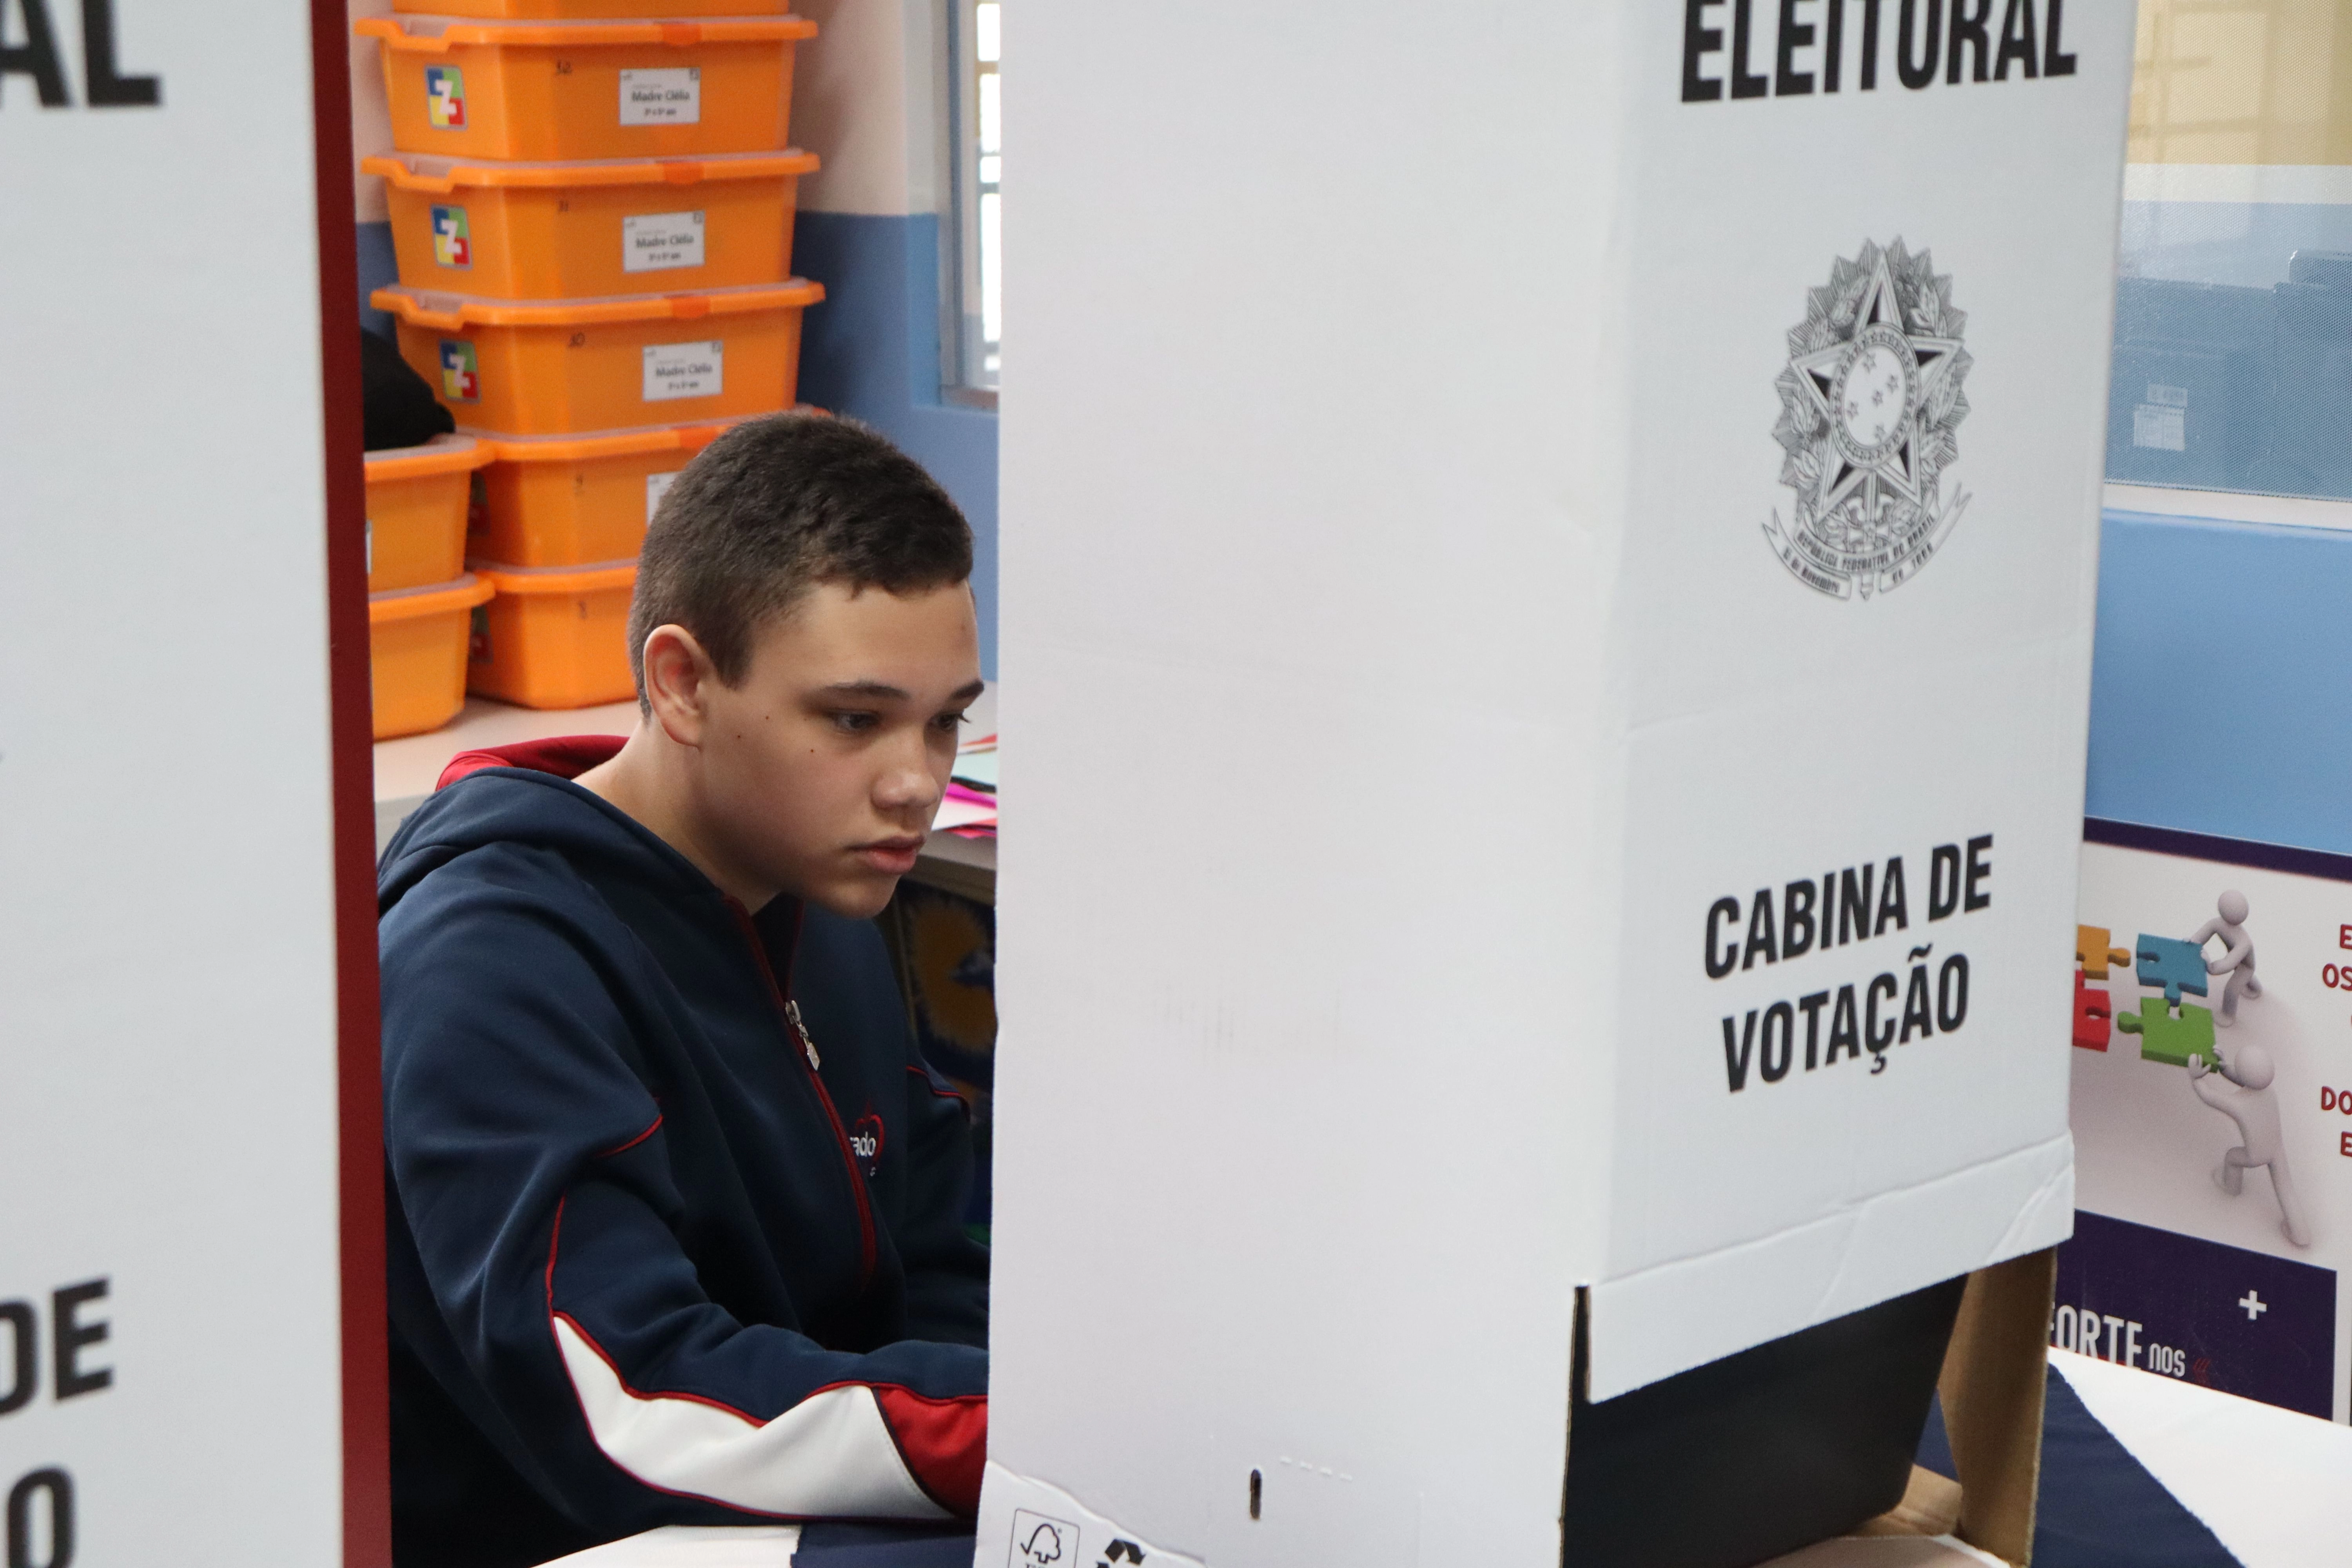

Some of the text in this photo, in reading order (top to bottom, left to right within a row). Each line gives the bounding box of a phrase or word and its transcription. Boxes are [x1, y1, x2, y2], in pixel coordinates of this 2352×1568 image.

[1705, 834, 1993, 980] CABINA DE
[1722, 942, 1969, 1093] VOTAÇÃO
